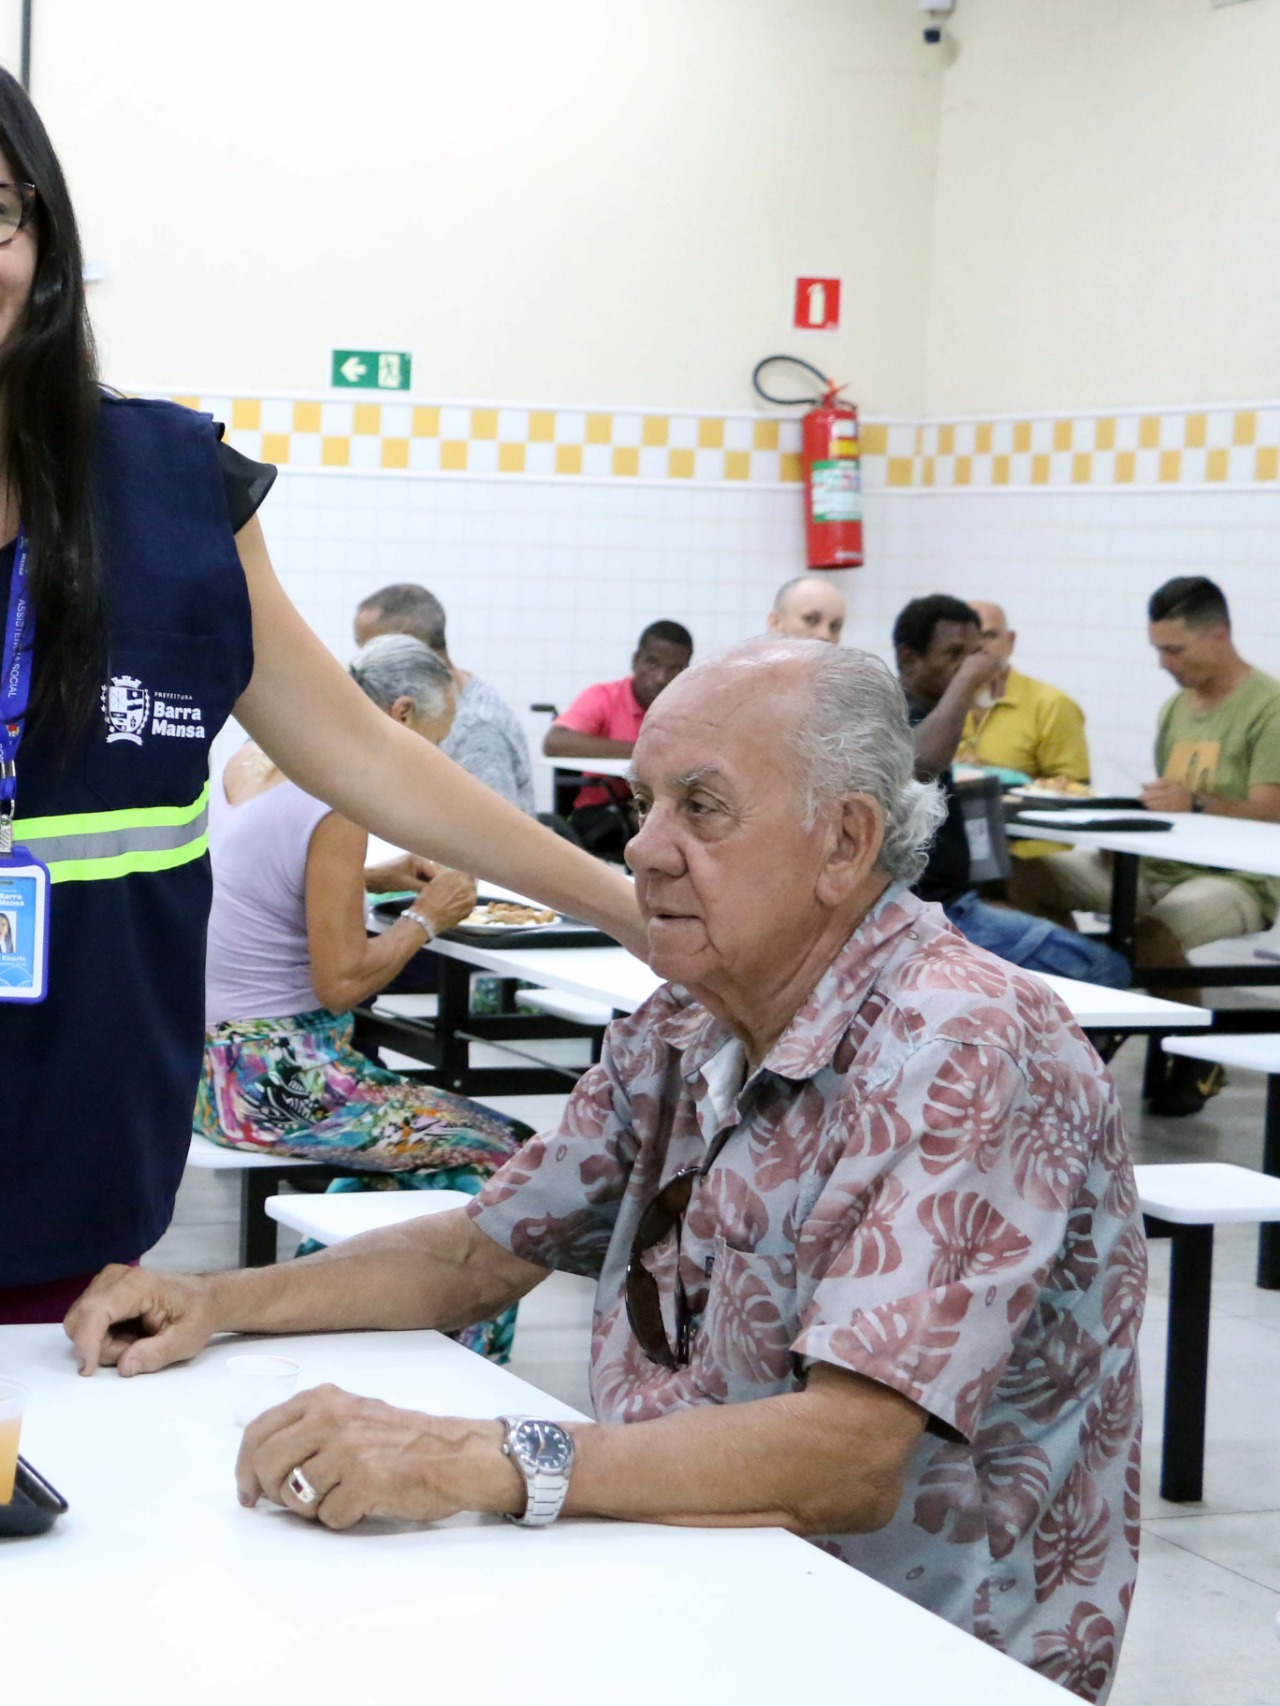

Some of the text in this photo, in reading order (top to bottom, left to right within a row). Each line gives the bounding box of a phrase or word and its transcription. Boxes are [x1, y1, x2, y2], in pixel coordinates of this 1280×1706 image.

[8, 663, 20, 699] SOCIAL
[154, 691, 193, 700] PREFEITURA
[153, 701, 202, 721] Barra
[151, 718, 206, 739] Mansa
